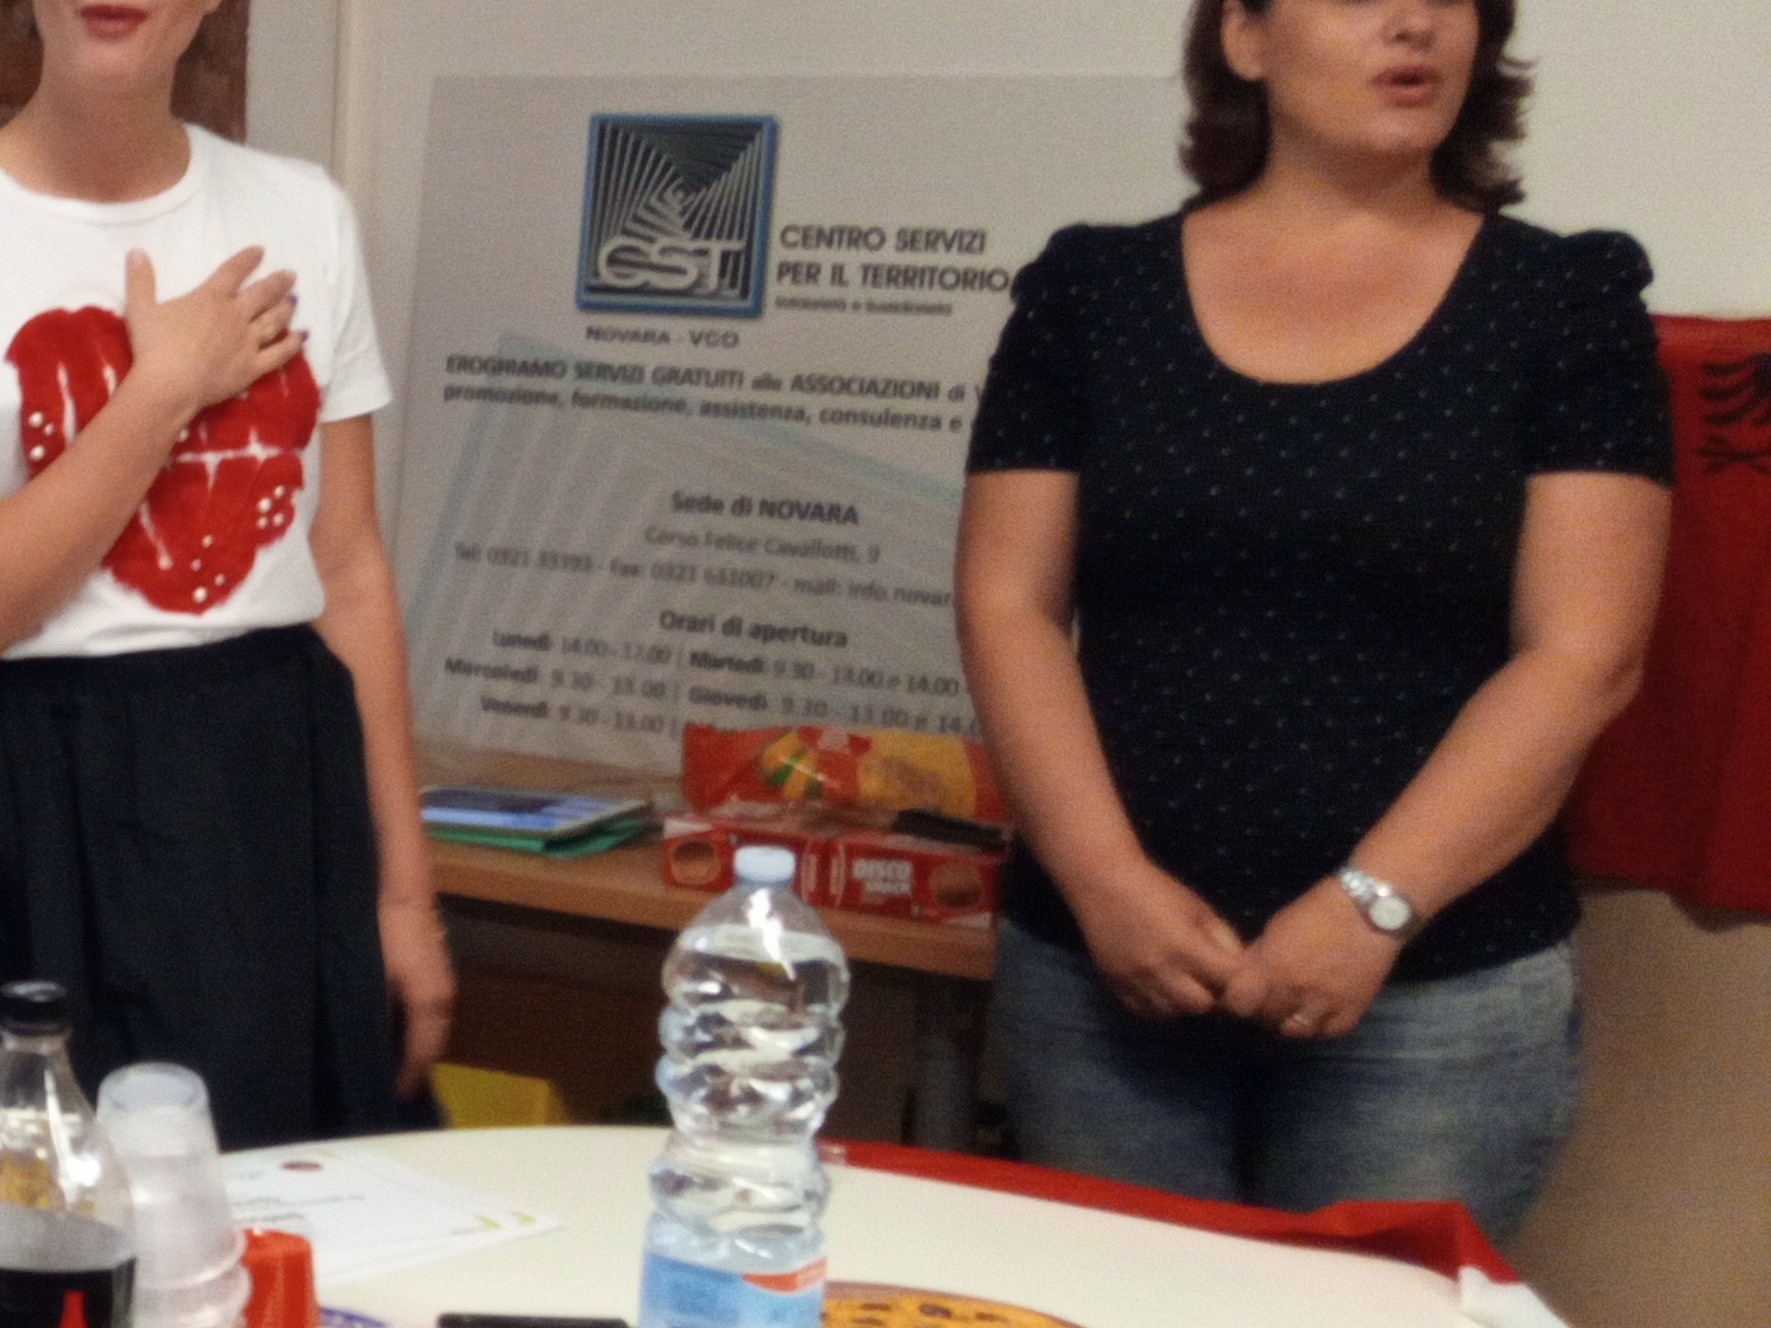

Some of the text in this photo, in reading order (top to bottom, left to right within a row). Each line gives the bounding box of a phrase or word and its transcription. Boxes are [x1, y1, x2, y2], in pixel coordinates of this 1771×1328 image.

[780, 224, 987, 254] CENTRO SERVIZI
[777, 260, 1010, 292] PER IL TERRITORIO
[585, 326, 671, 345] NOVARA
[789, 373, 941, 400] ASSOCIAZIONI
[819, 408, 943, 431] consulenza
[759, 498, 859, 524] NOVARA
[748, 622, 849, 648] apertura
